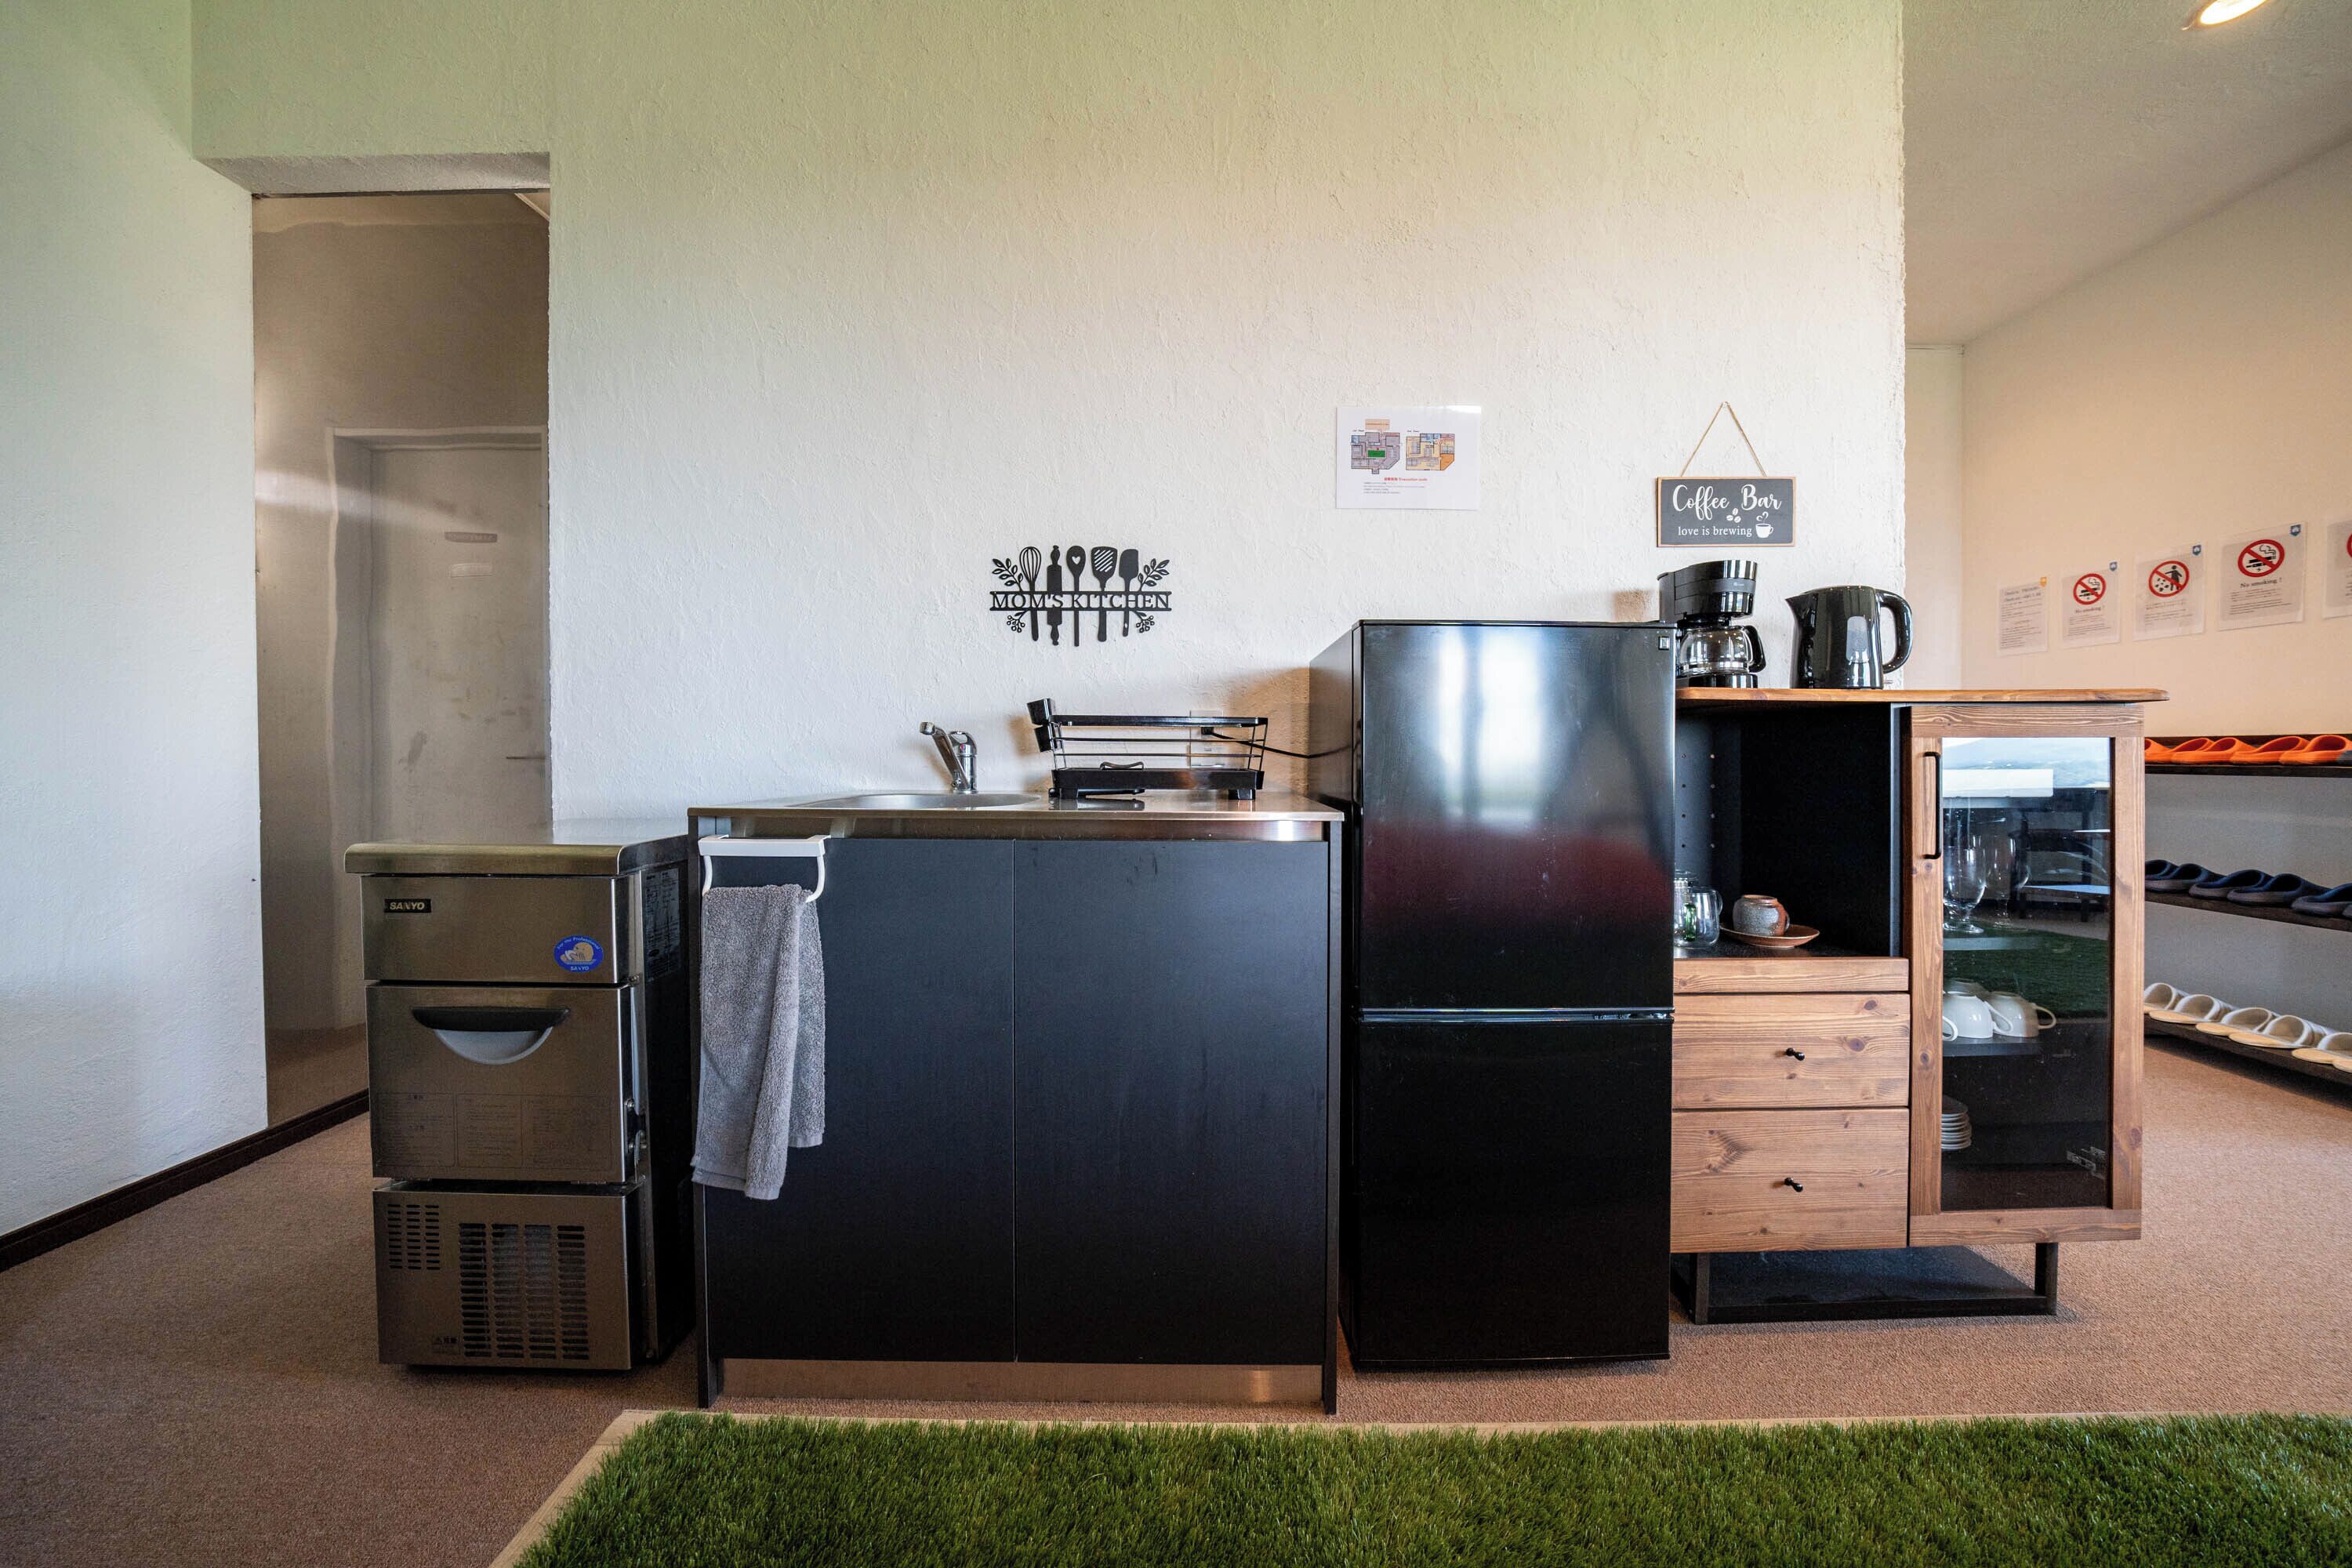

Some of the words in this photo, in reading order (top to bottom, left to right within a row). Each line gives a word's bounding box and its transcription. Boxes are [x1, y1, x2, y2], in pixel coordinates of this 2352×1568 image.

[1672, 484, 1730, 521] Coffee
[1741, 484, 1782, 511] Bar
[1678, 526, 1699, 535] love
[1702, 526, 1710, 535] is
[1713, 526, 1752, 537] brewing
[992, 593, 1064, 608] MOM'S
[1071, 593, 1169, 608] KITCHEN
[390, 902, 425, 910] SANYO
